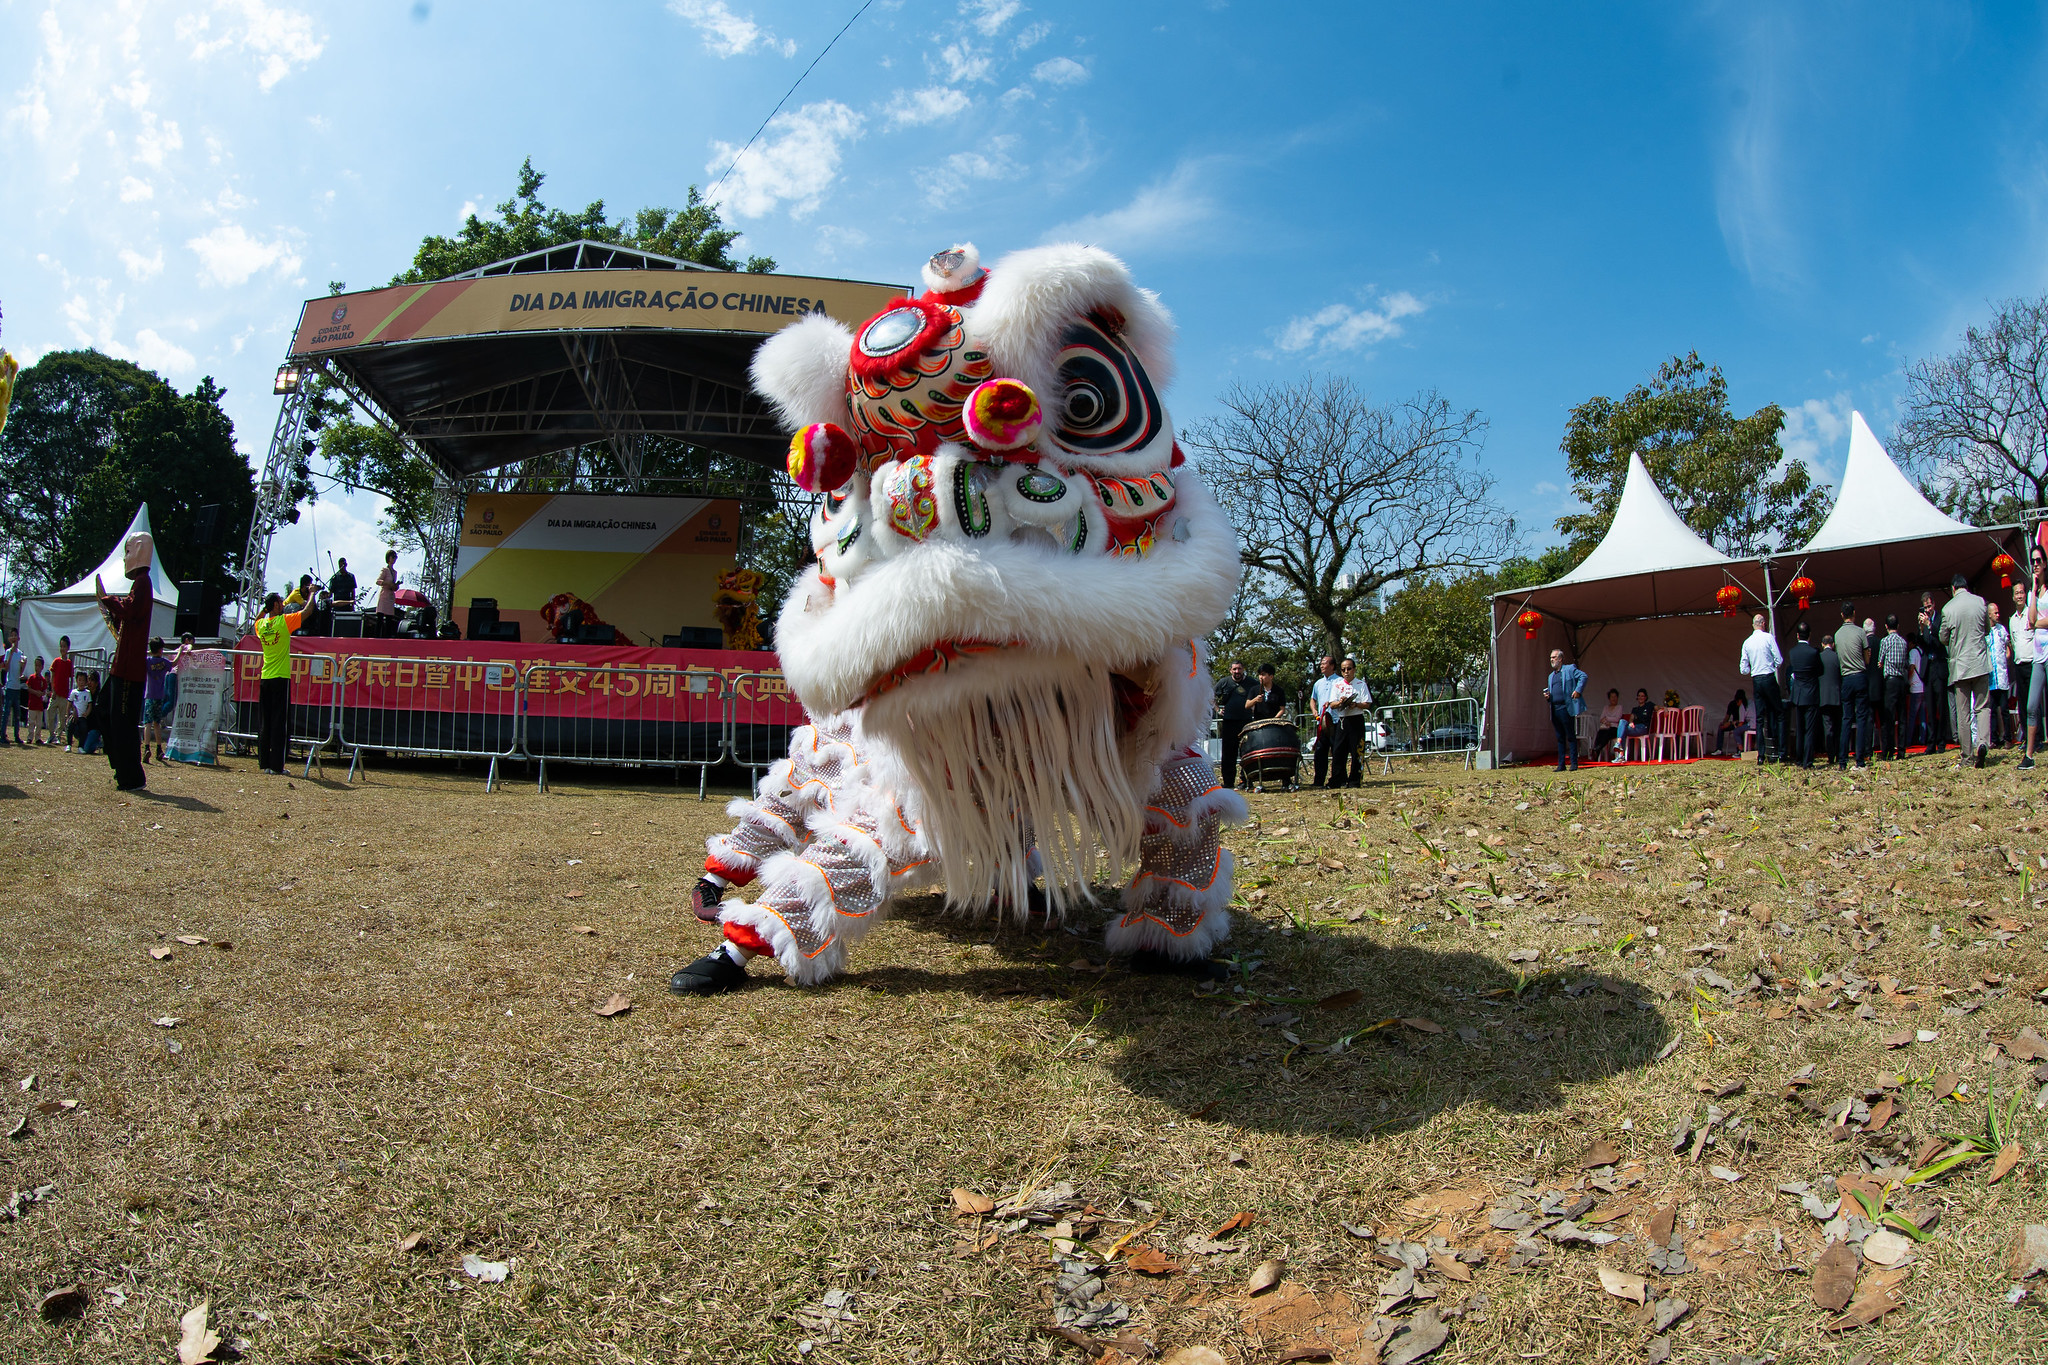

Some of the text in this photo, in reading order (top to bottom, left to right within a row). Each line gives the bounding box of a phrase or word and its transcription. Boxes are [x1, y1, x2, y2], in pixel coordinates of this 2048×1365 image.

[509, 286, 827, 317] DIA DA IMIGRAÇÃO CHINESA
[318, 323, 351, 335] CIDADE DE
[311, 331, 354, 344] SÃO PAULO
[548, 518, 657, 530] DIA DA IMIGRAÇÃO CHINESA
